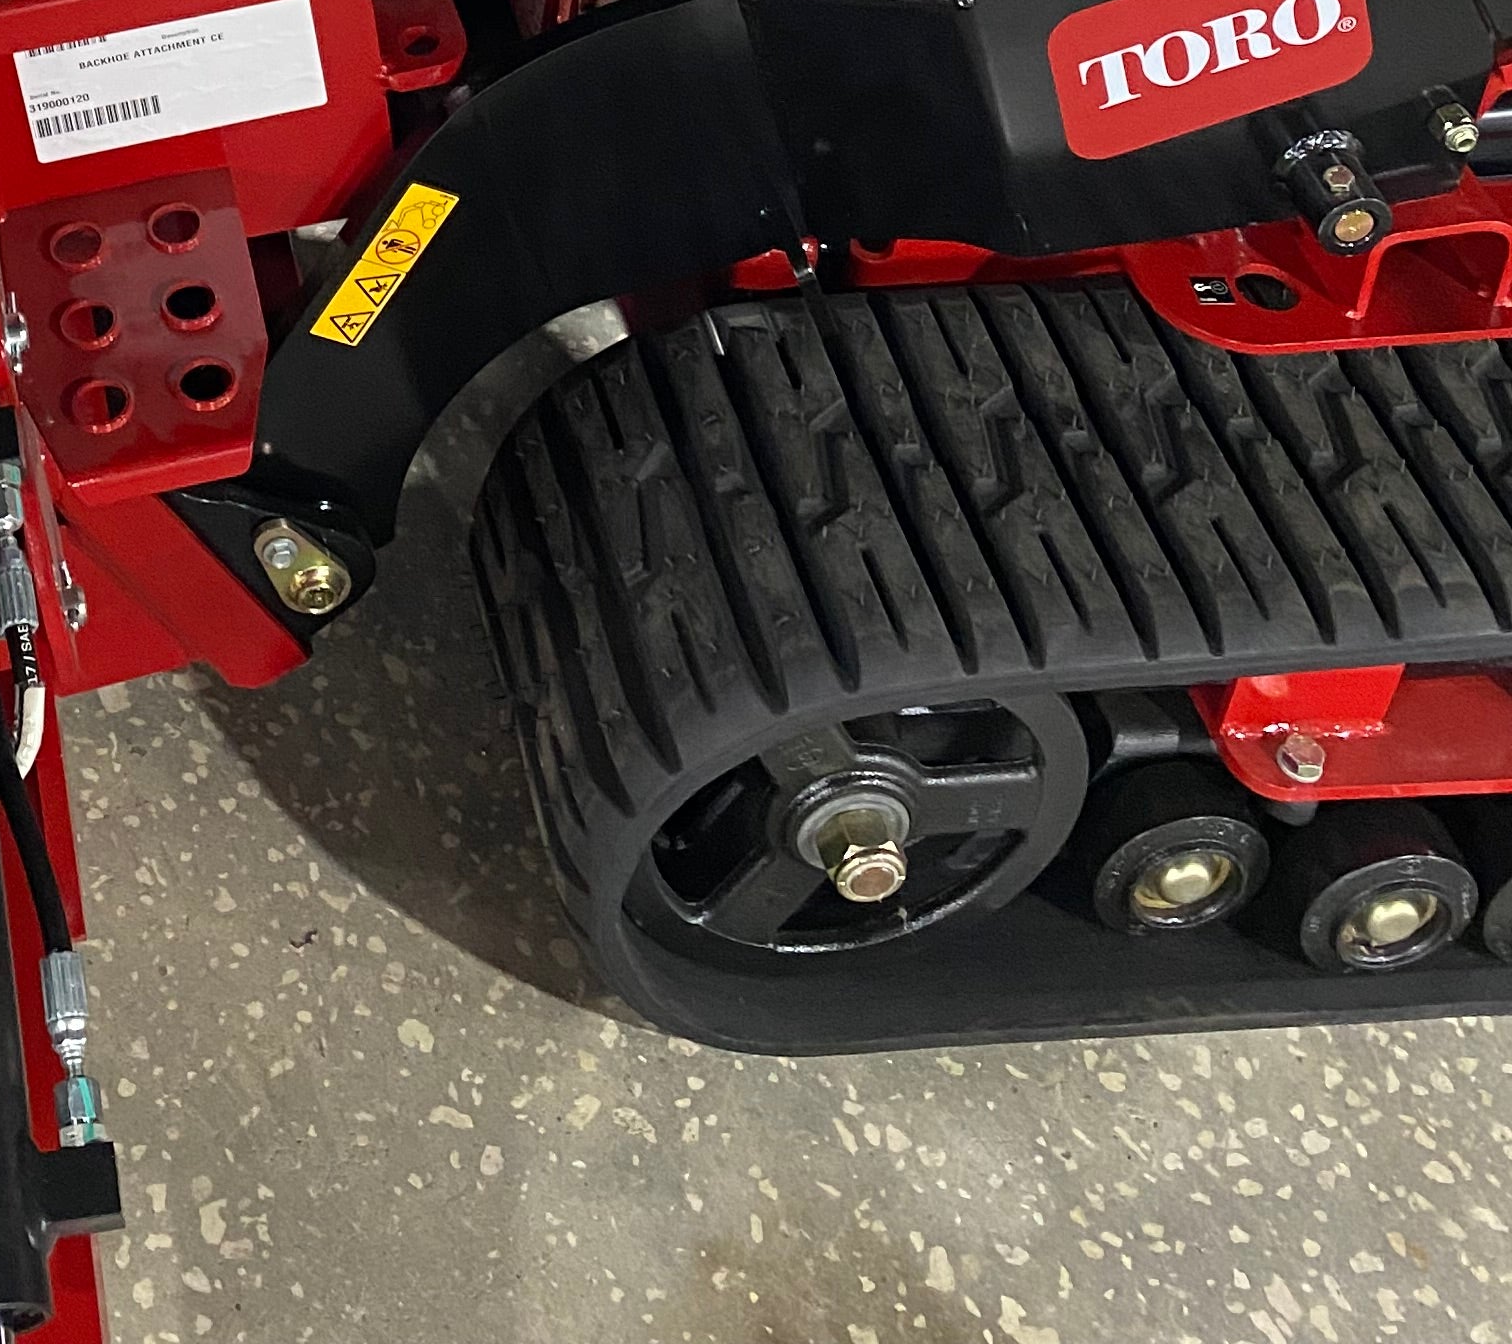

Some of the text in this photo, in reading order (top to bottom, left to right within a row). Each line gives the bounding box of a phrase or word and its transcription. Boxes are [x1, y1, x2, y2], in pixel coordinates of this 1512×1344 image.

[78, 32, 225, 70] BACKHOE ATTACHMENT CE
[28, 93, 90, 114] 319000120
[17, 623, 33, 652] SAE
